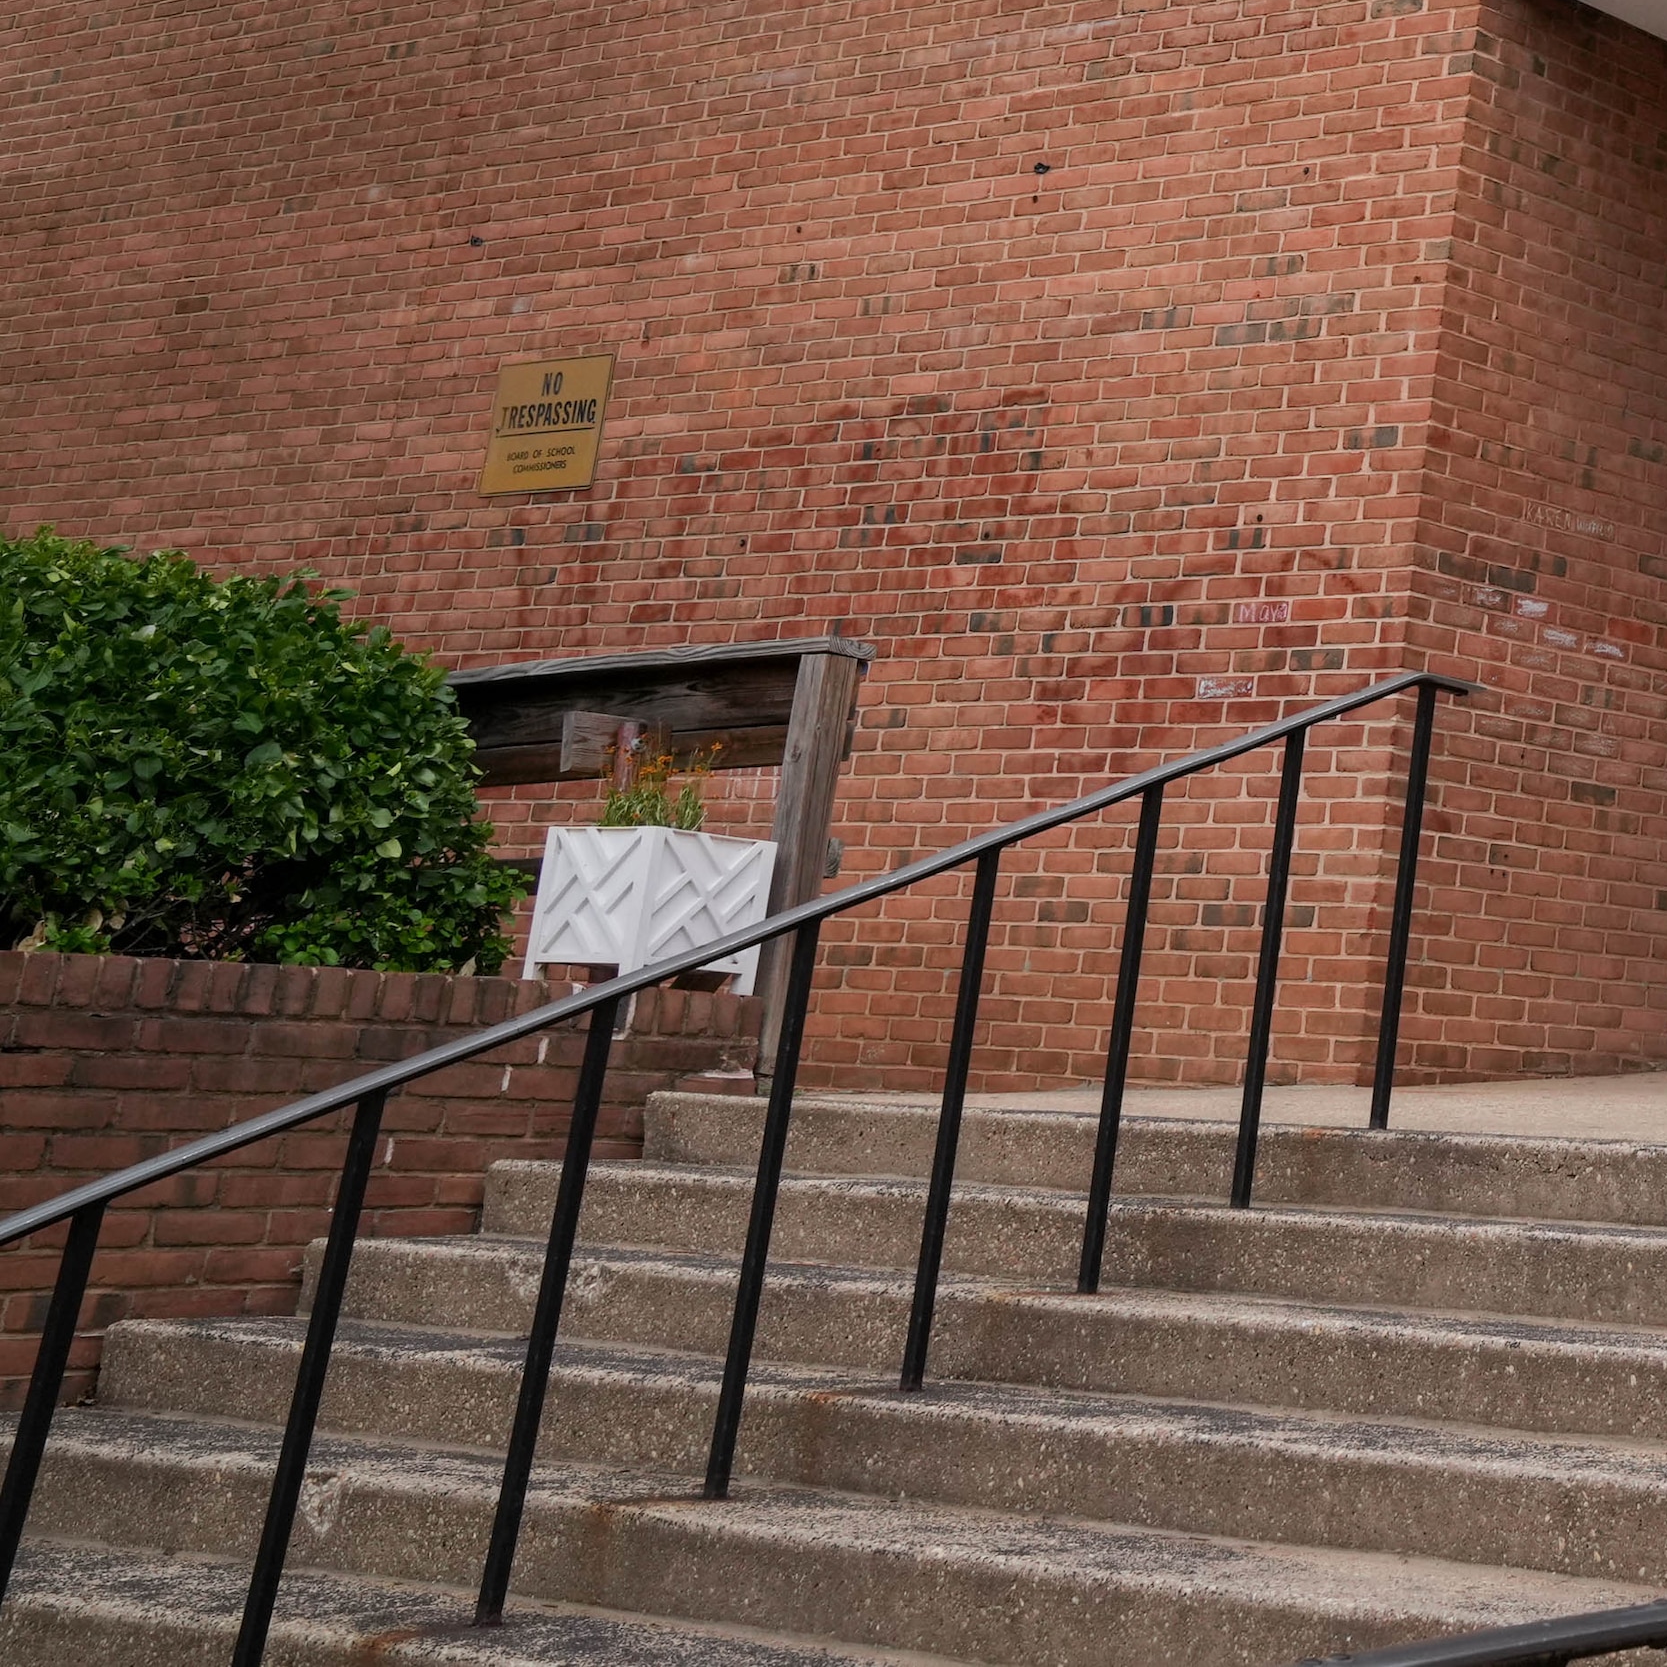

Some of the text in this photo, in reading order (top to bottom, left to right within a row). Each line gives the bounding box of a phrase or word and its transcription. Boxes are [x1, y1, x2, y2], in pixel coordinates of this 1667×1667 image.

[542, 371, 563, 396] NO
[501, 399, 597, 430] TRESPASSING
[507, 446, 575, 461] BOARD OF SCHOOL
[513, 460, 567, 474] COMMISSIONERS
